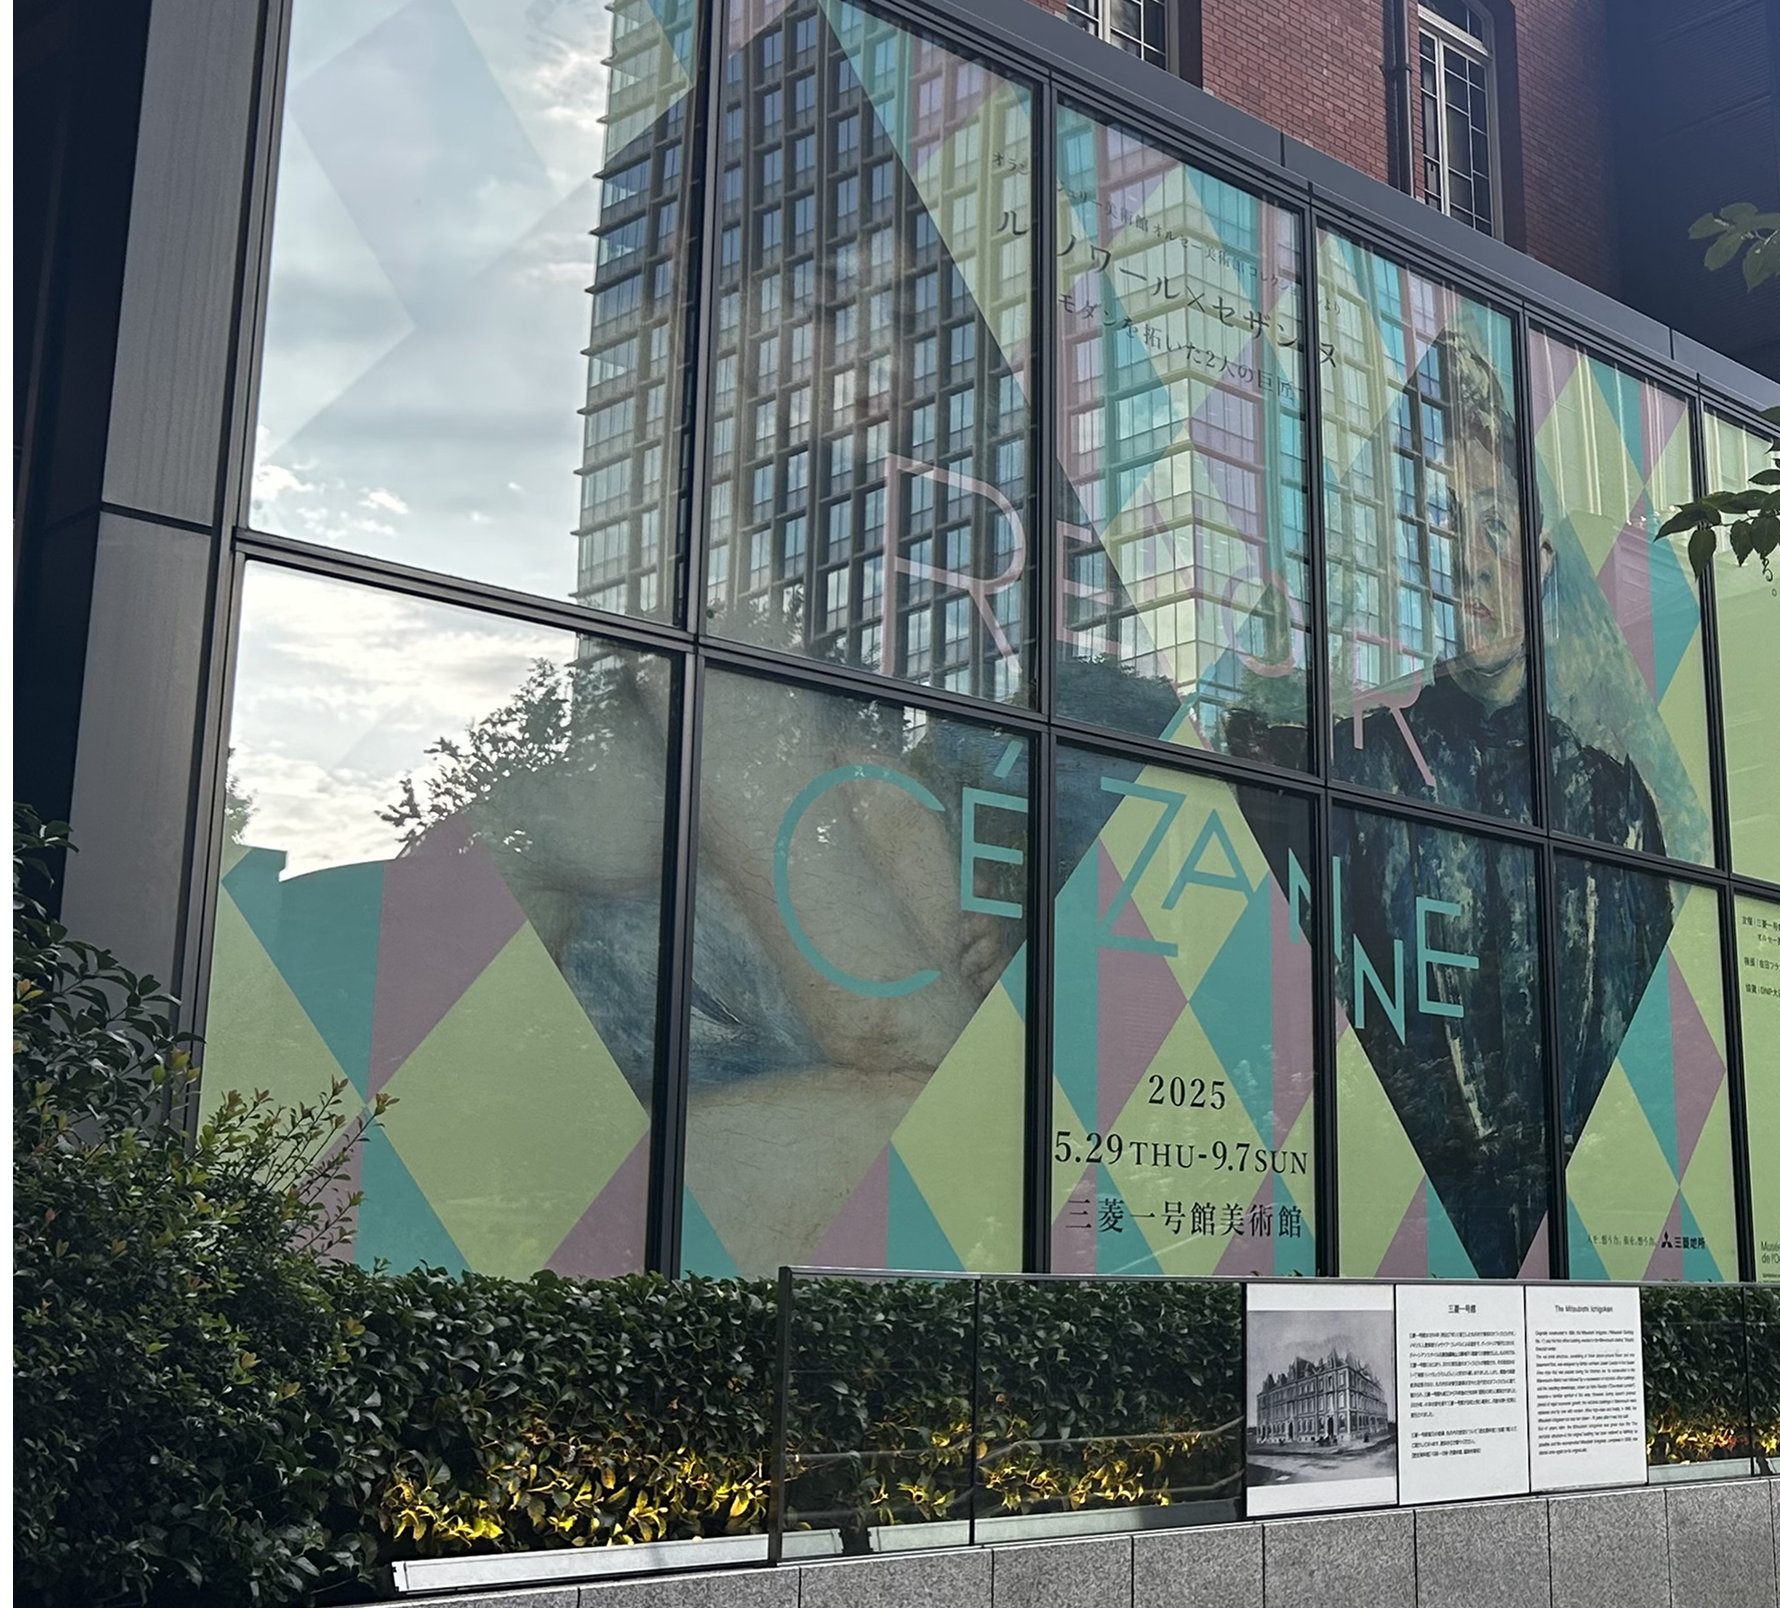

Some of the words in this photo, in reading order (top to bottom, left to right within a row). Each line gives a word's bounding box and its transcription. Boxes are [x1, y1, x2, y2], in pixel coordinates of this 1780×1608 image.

[773, 742, 1480, 1044] CÉZANNE
[1147, 1074, 1227, 1111] 2025
[1065, 1197, 1302, 1239] 三菱一号館美術館
[1761, 1253, 1771, 1264] de
